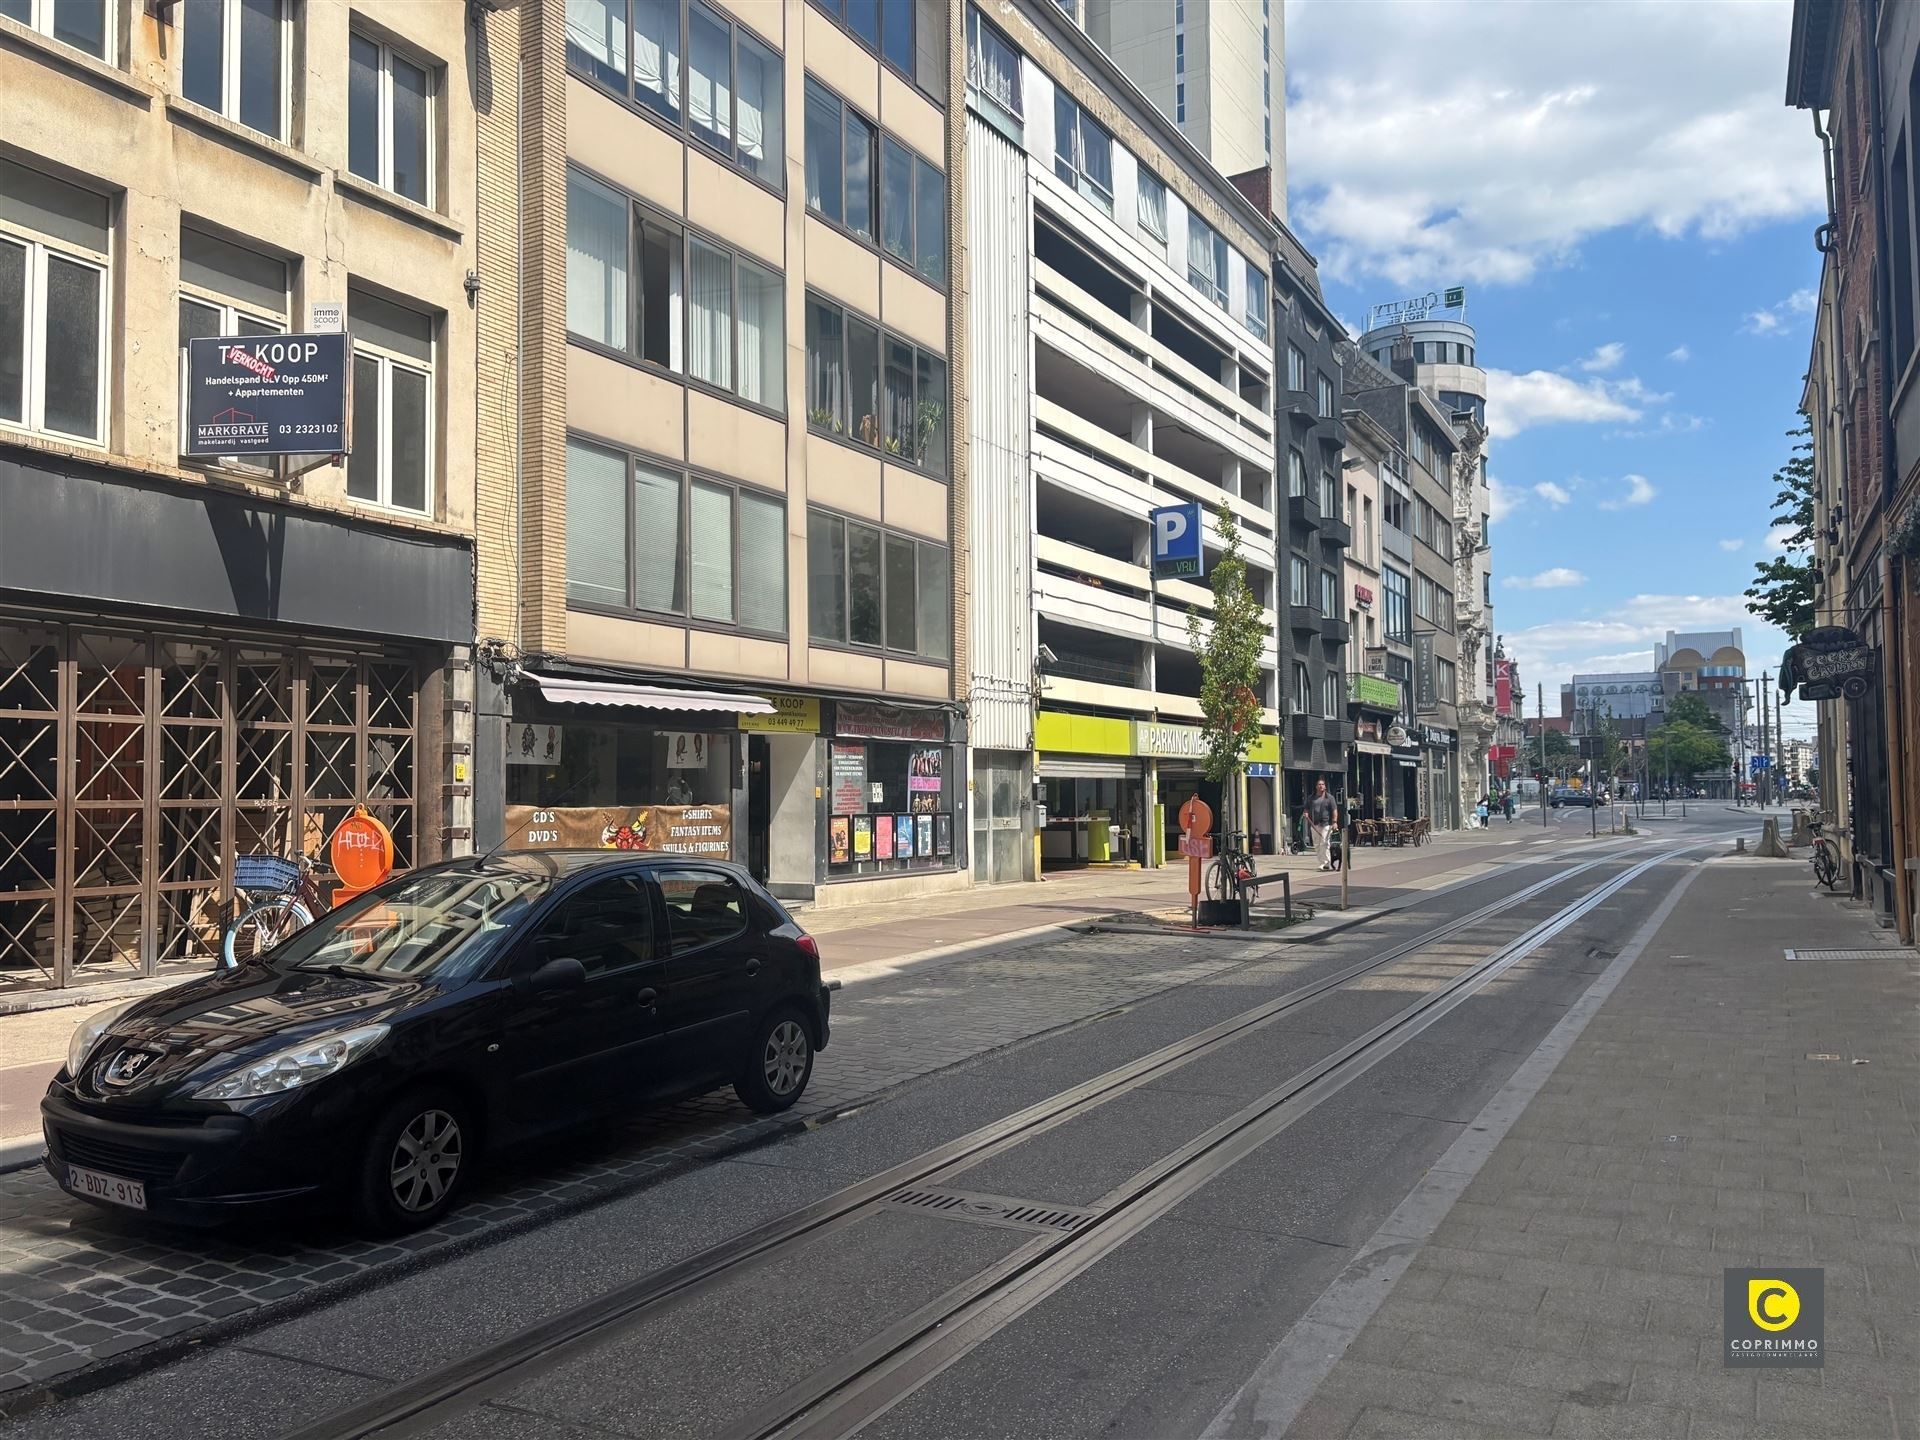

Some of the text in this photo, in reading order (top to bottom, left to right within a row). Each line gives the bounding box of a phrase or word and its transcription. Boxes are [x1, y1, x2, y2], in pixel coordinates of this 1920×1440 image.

[313, 307, 340, 316] immo
[313, 316, 339, 325] scoop
[255, 342, 318, 364] KOOP
[228, 348, 275, 378] VERKOCHT
[205, 375, 261, 386] Handelspand
[281, 374, 300, 385] Opp
[234, 387, 304, 398] Appartementen
[198, 423, 339, 436] MARKGRAVE 03 2323102
[197, 438, 236, 446] makelaardij
[1156, 511, 1187, 556] P
[1496, 663, 1508, 676] K
[780, 697, 804, 709] KOOP
[777, 718, 788, 726] 449
[797, 719, 804, 727] 77
[1150, 727, 1189, 755] PARKING
[532, 811, 555, 823] CD'S
[682, 809, 713, 820] T-SHIRTS
[528, 829, 558, 843] DVD'S
[670, 825, 722, 837] FANTASY ITEMS
[688, 842, 695, 853] &
[694, 841, 729, 852] FIGURINES
